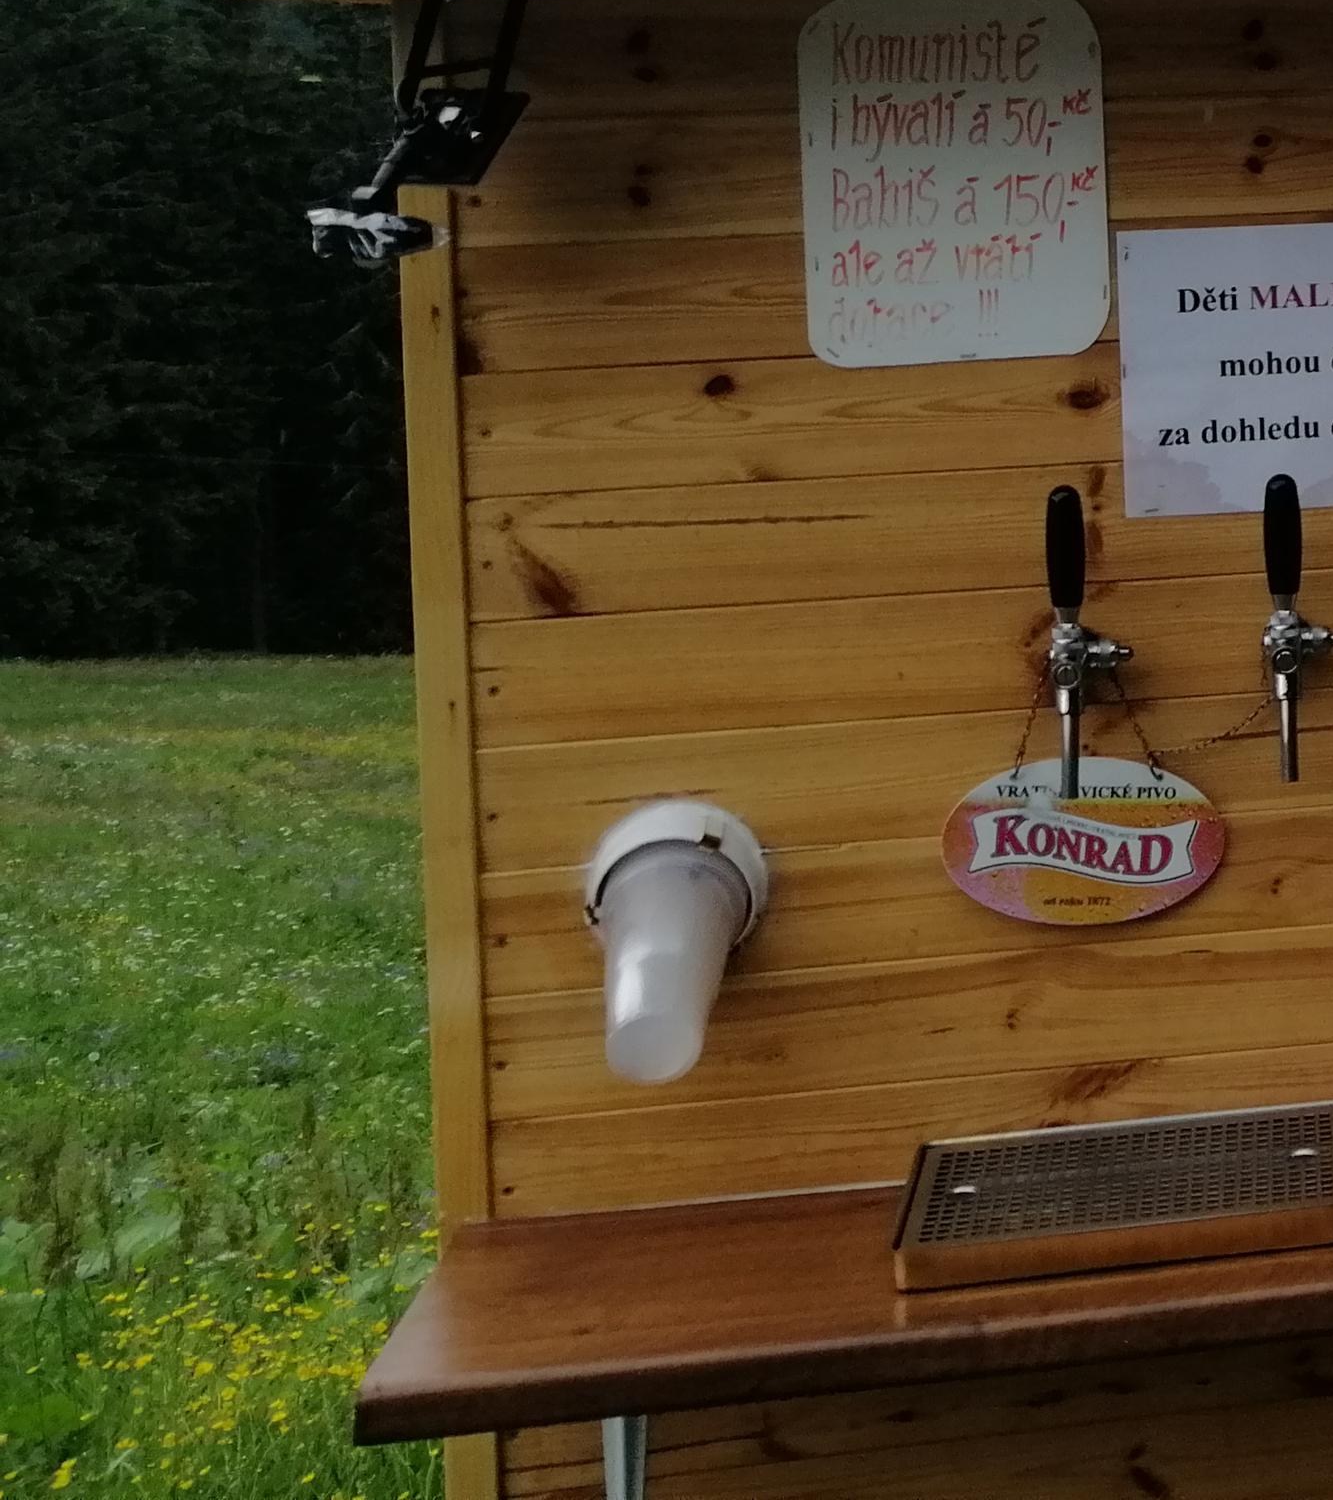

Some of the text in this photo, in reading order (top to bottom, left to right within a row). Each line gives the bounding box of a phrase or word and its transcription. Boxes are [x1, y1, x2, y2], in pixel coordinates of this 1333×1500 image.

[831, 16, 1047, 85] Komunisté
[831, 98, 838, 151] i
[832, 164, 941, 232] Babiš
[831, 239, 885, 287] ale
[1176, 284, 1239, 314] Děti
[1219, 350, 1320, 377] mohou
[1158, 426, 1190, 447] za
[1201, 415, 1320, 445] dohledu
[996, 784, 1177, 799] VRATVICKÉ PIVO
[991, 814, 1174, 876] KONRAD
